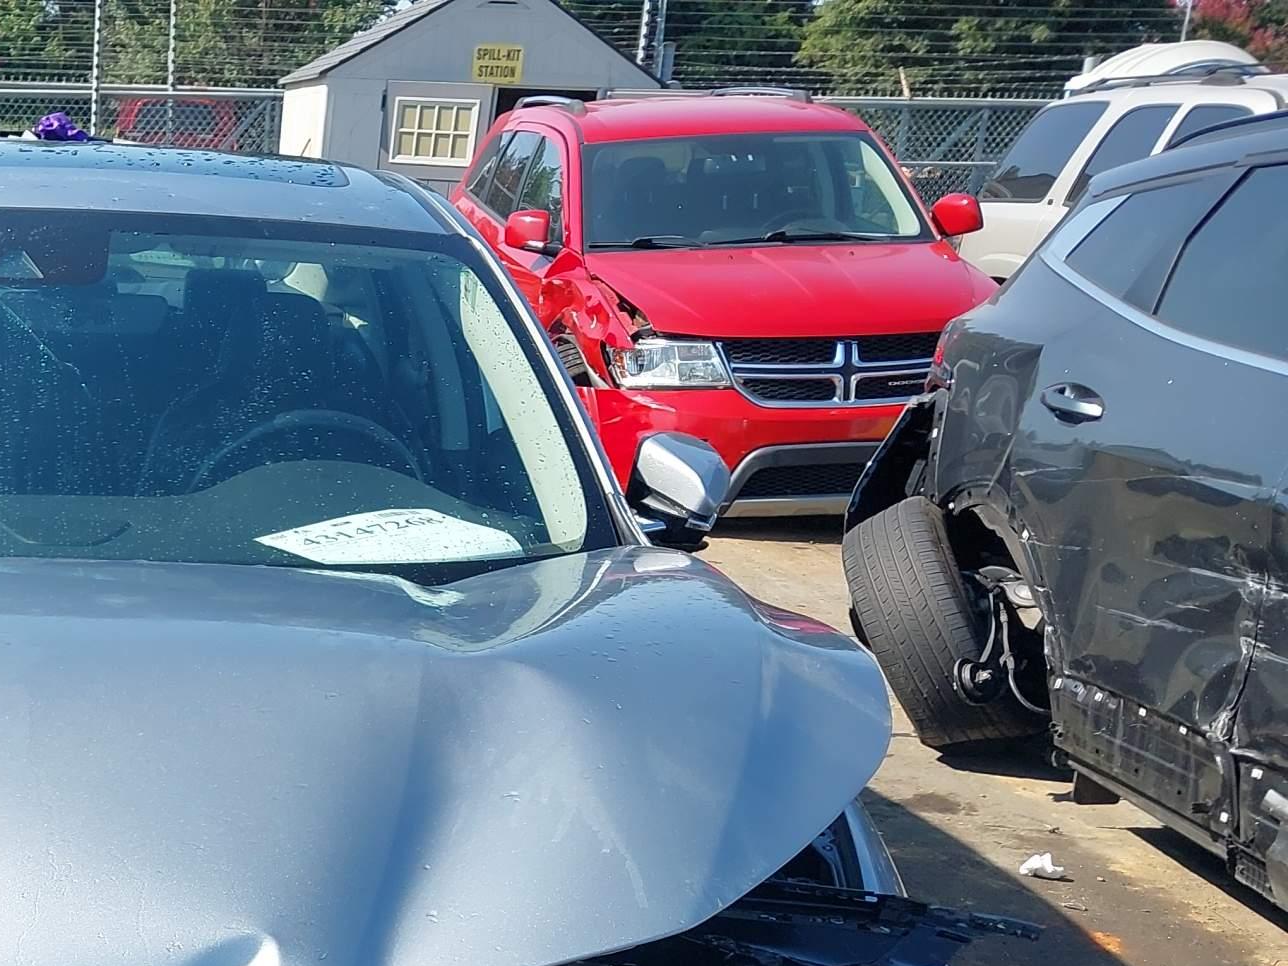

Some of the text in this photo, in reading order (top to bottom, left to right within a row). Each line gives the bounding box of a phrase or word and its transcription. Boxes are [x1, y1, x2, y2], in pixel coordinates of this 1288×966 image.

[477, 48, 521, 61] SPILL-KIT
[478, 65, 516, 78] STATION
[303, 516, 444, 546] 43147268
